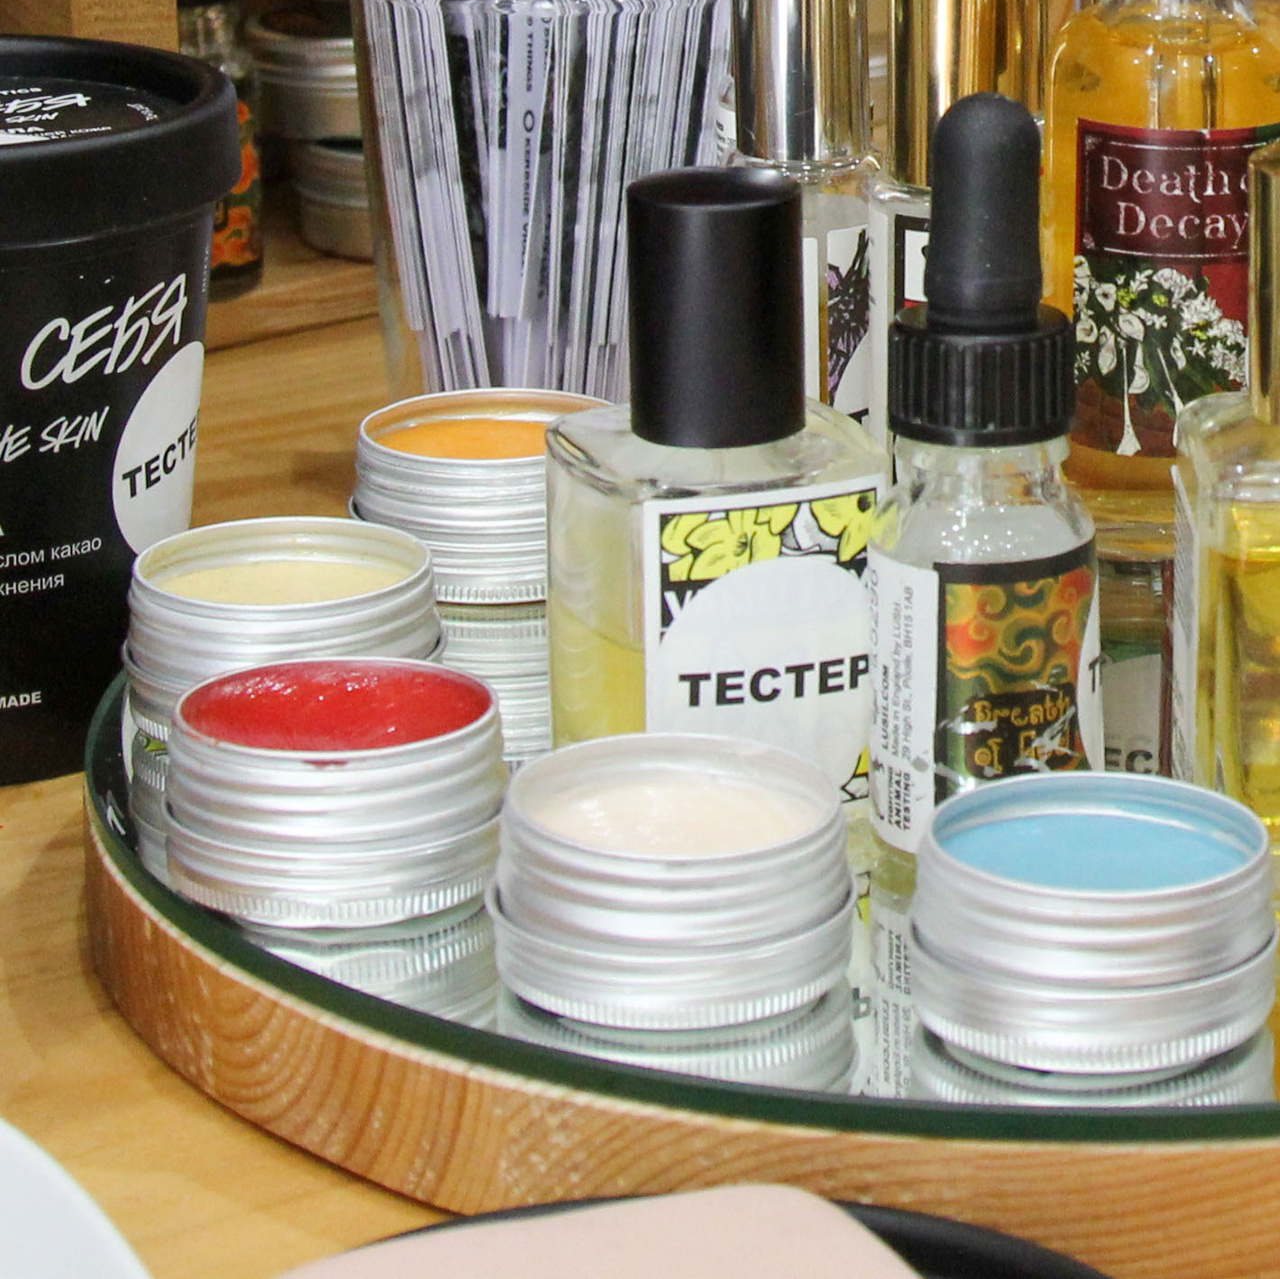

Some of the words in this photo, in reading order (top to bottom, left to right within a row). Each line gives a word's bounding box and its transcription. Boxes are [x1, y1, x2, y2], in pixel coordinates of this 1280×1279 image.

[1102, 154, 1231, 204] Death
[1116, 202, 1250, 250] Decay
[21, 273, 188, 391] СЕБЯ
[39, 405, 110, 454] SKIN
[122, 412, 200, 499] ТЕСТЕ
[0, 549, 45, 569] слом
[51, 537, 102, 561] какао
[903, 614, 912, 649] BH15
[678, 654, 869, 707] ТЕСТЕР
[894, 769, 902, 829] ANIMAL
[902, 772, 911, 831] TESTING
